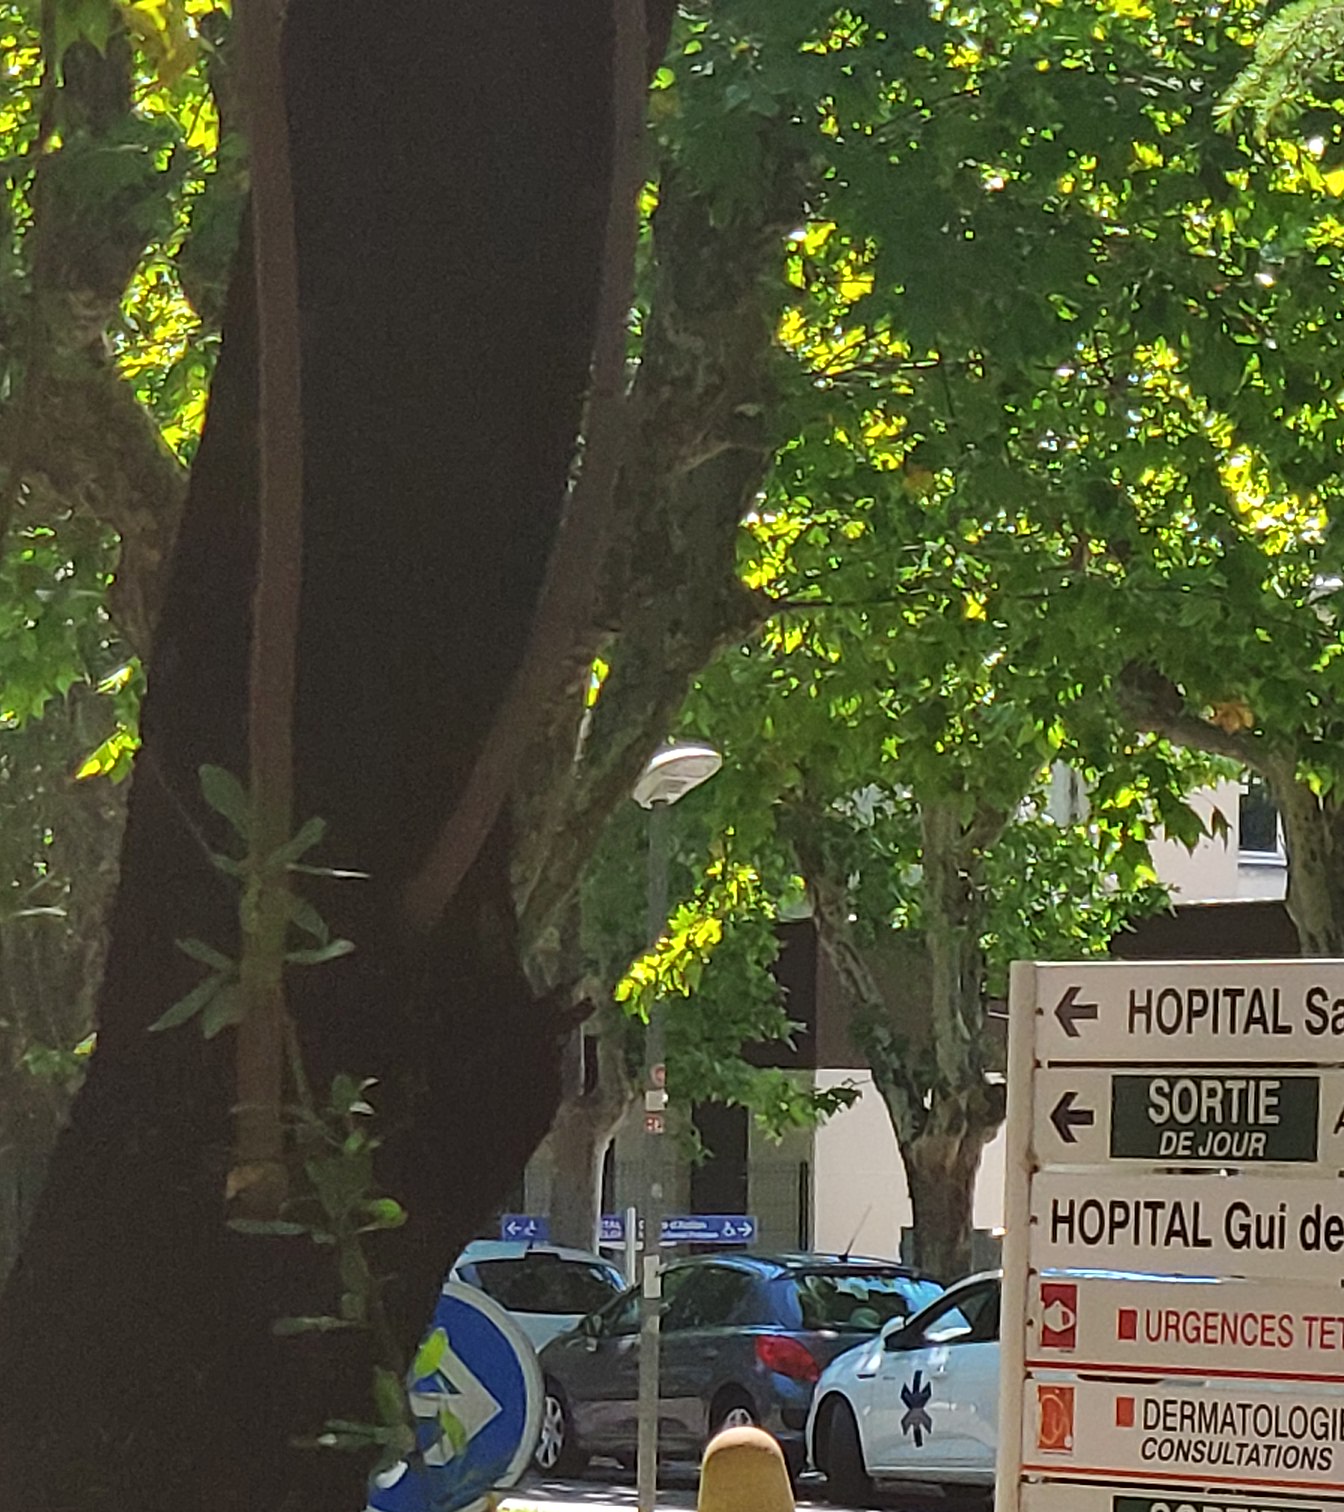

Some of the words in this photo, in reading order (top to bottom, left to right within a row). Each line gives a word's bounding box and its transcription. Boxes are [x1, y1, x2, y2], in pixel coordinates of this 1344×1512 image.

[1128, 987, 1293, 1035] HOPITAL
[1148, 1078, 1281, 1125] SORTIE
[1159, 1131, 1194, 1156] DE
[1198, 1131, 1267, 1157] JOUR
[1051, 1199, 1212, 1248] HOPITAL
[1224, 1201, 1286, 1250] Gui
[1300, 1203, 1344, 1252] de
[1145, 1308, 1294, 1348] URGENCES
[1141, 1437, 1333, 1471] CONSULTATIONS
